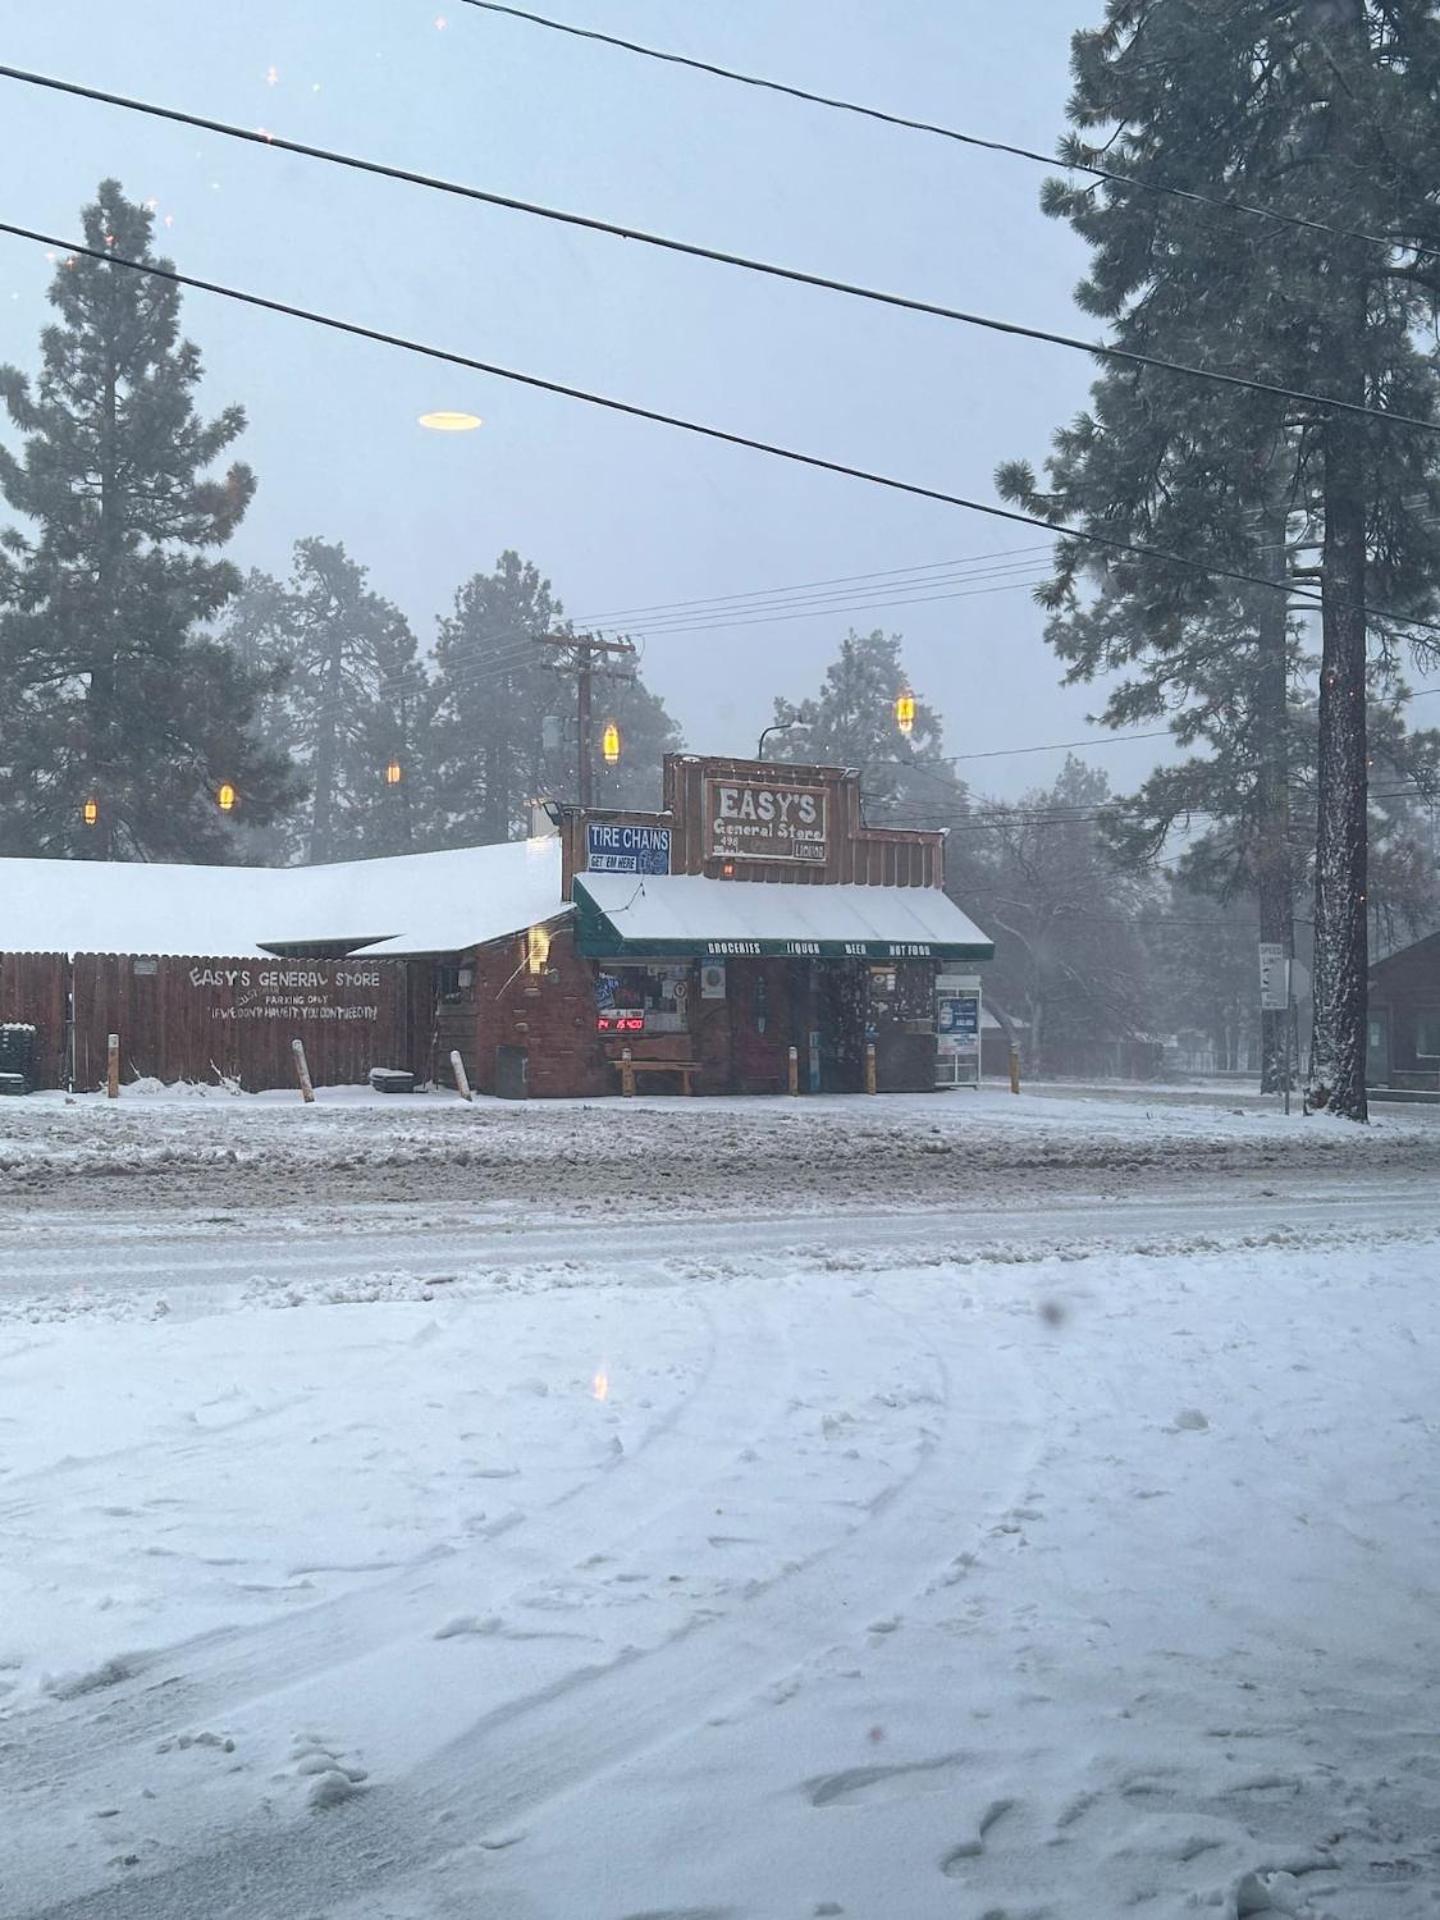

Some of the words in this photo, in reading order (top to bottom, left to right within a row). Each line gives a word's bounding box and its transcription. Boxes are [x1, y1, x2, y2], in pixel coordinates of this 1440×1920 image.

[720, 788, 816, 823] EASY'S
[713, 818, 773, 837] General
[777, 823, 822, 839] Store
[591, 826, 620, 847] TIRE
[623, 829, 668, 850] CHAINS
[591, 855, 603, 867] GET
[617, 857, 636, 869] HERE
[707, 942, 761, 954] GROCERIES
[786, 942, 820, 954] LIQUOR
[844, 943, 867, 955] BEER
[889, 945, 907, 956] HOT
[908, 945, 931, 956] FOOD
[1260, 946, 1281, 955] SPEED
[189, 966, 251, 987] EASY'S
[258, 971, 328, 987] GENERAL
[335, 972, 380, 987] STORE
[265, 995, 305, 1005] PARKING
